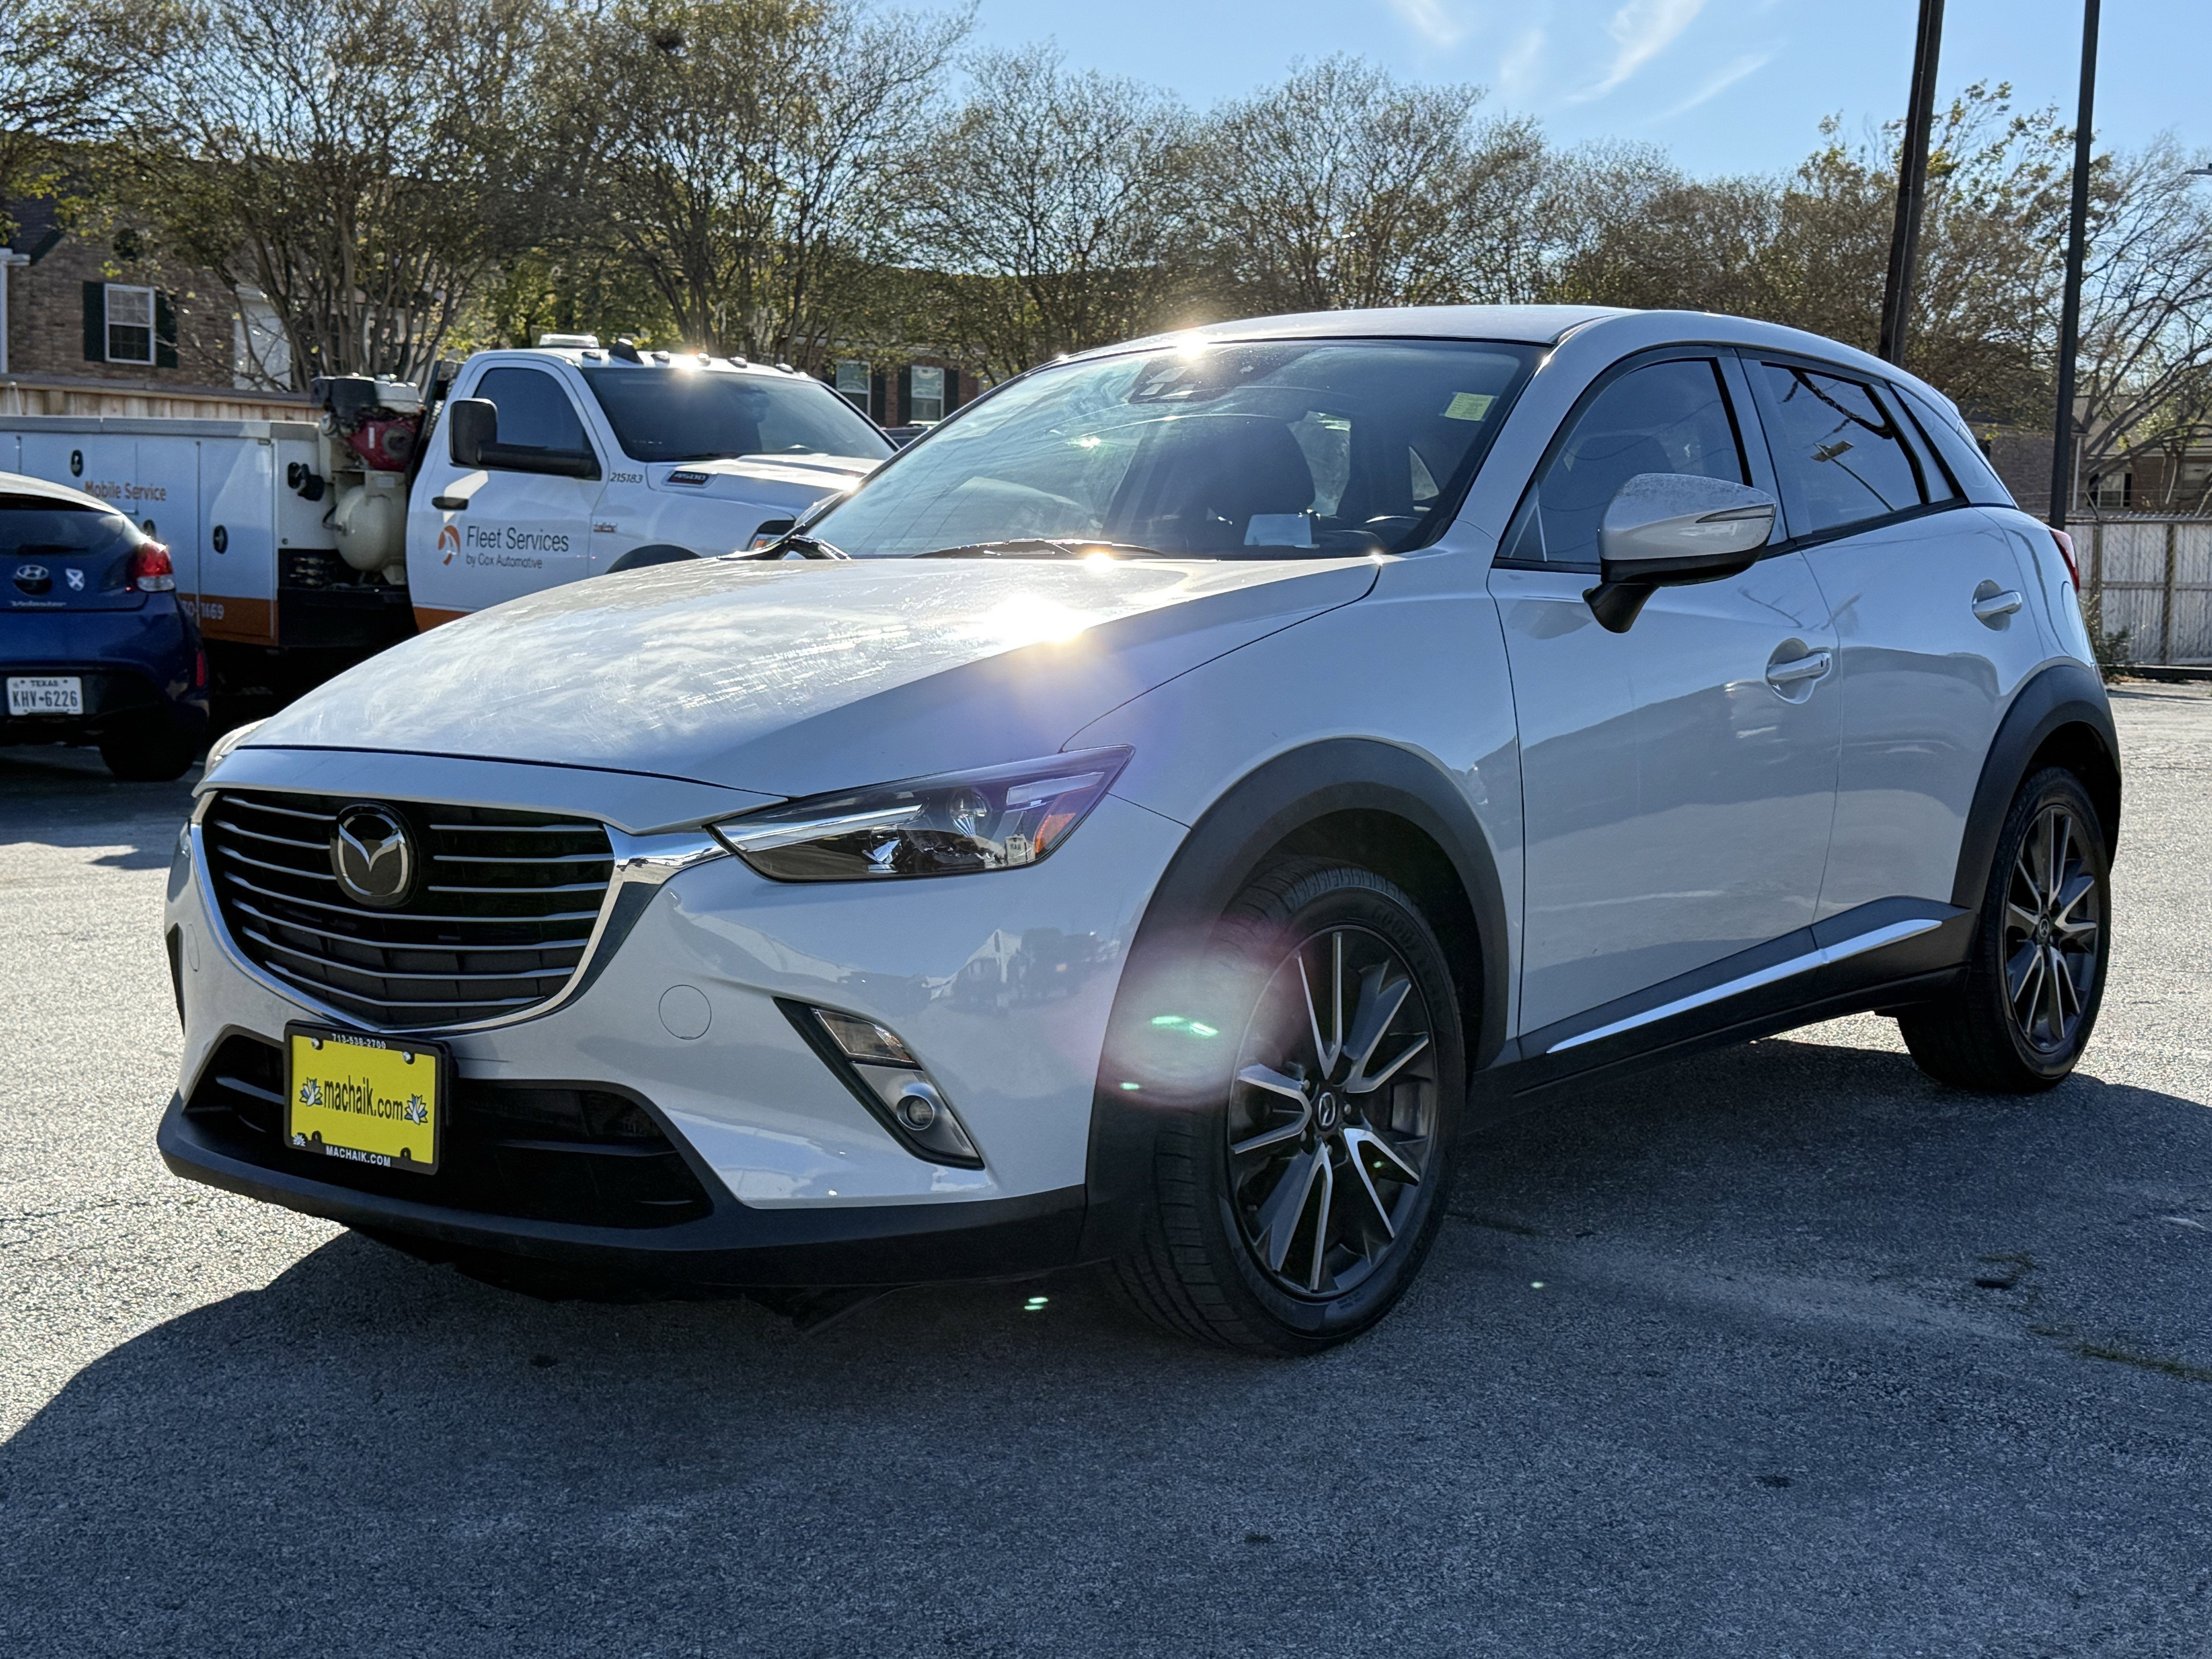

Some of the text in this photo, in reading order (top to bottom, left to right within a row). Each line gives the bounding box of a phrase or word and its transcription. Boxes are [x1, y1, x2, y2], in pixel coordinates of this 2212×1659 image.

[610, 472, 643, 483] 215183
[85, 480, 166, 501] Mobile Service
[467, 526, 569, 552] Fleet Services
[466, 553, 543, 568] by Cox Automotive
[12, 690, 78, 707] KHV-6226
[332, 1033, 386, 1049] 713-538-2700
[324, 1075, 403, 1121] machaik.com
[326, 1146, 391, 1167] MACHAIK.COM
